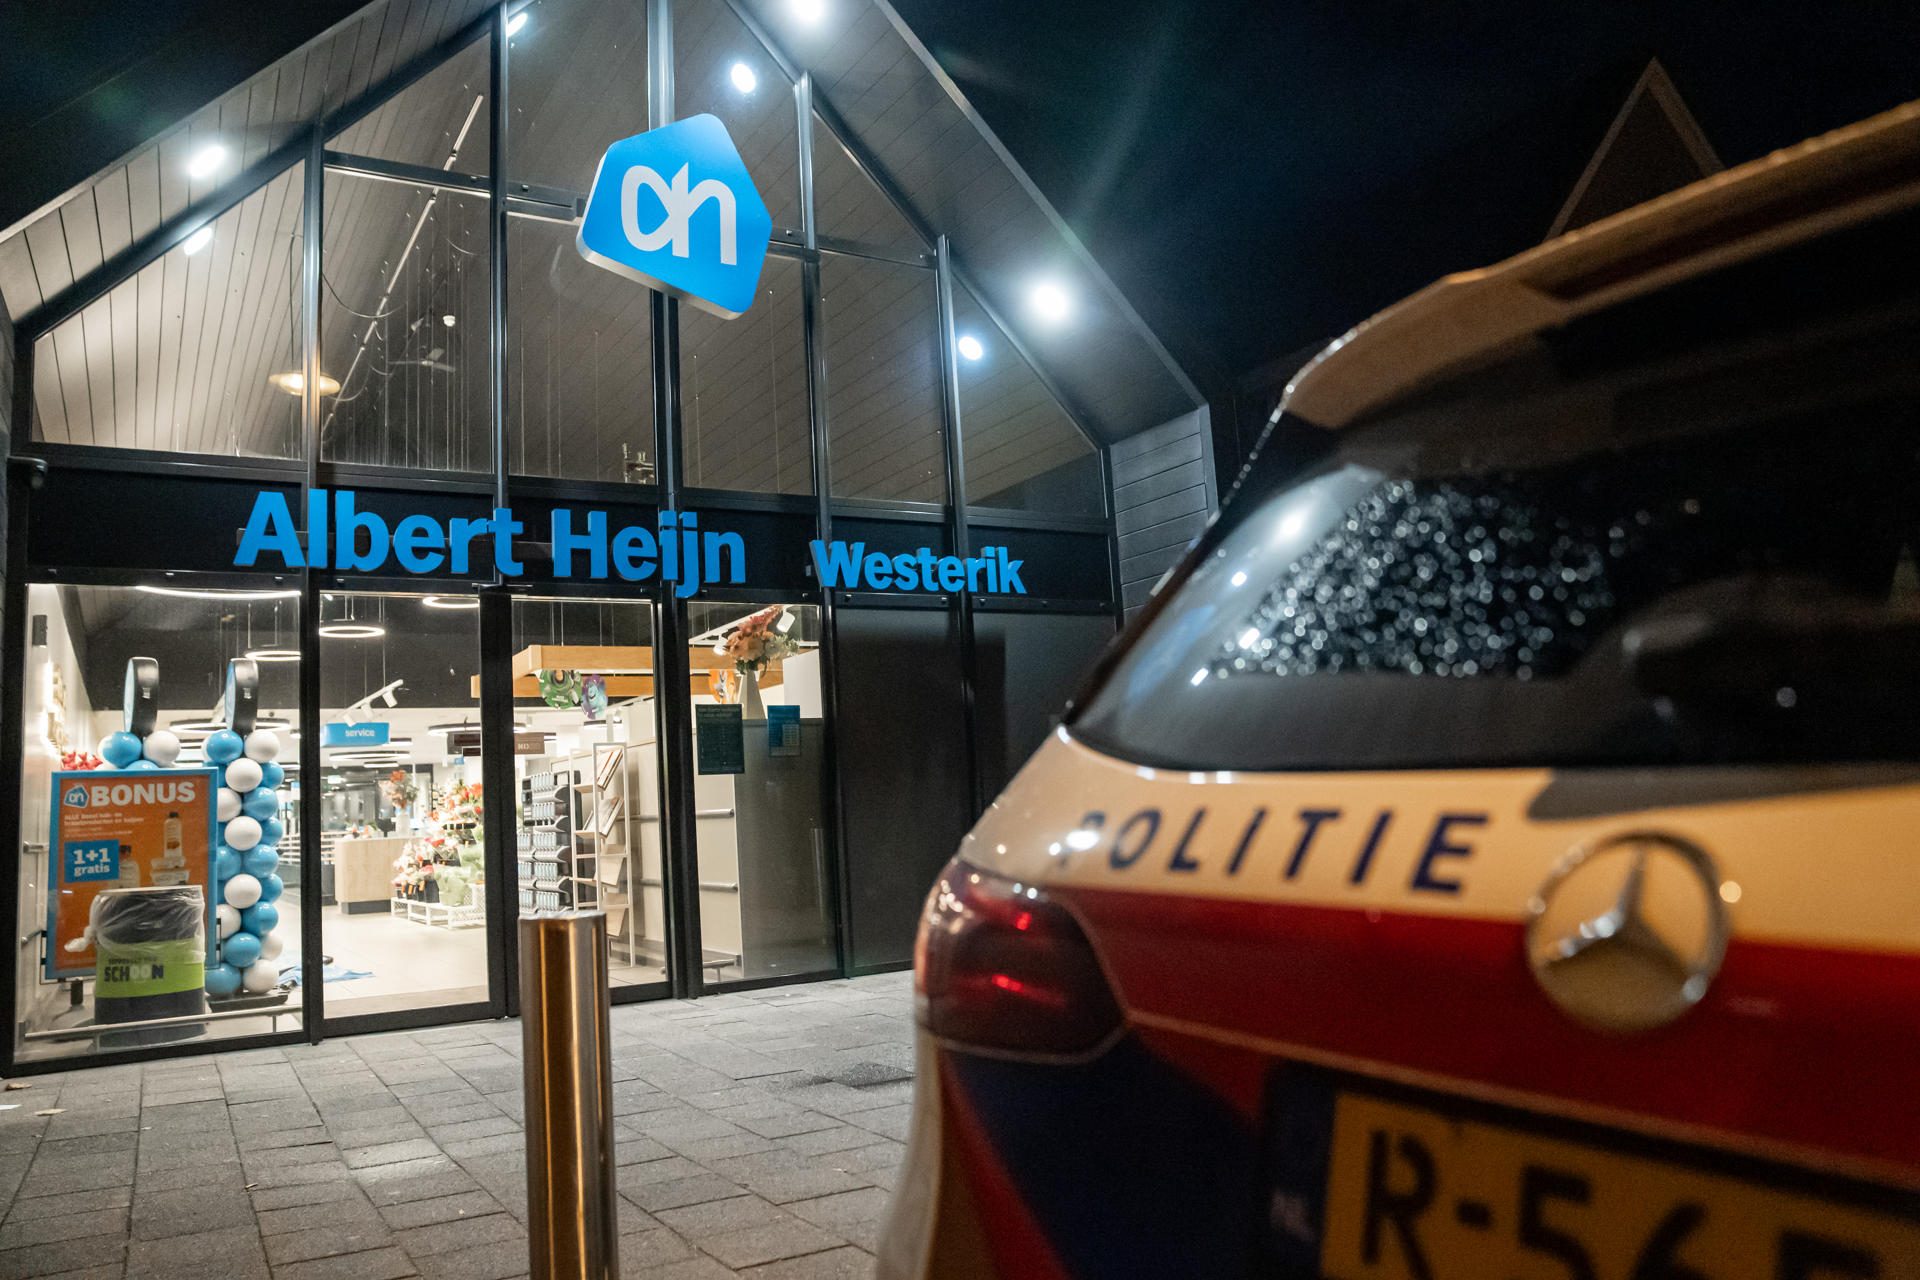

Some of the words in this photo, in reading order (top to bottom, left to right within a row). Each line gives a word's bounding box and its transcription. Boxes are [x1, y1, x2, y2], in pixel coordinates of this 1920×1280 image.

[233, 488, 524, 577] Albert
[551, 508, 747, 598] Heijn
[809, 539, 1028, 594] Westerik
[345, 729, 375, 737] service
[91, 781, 196, 807] BONUS
[73, 847, 111, 865] 1+1
[1057, 806, 1489, 894] POLITIE
[74, 863, 111, 877] gratis
[104, 964, 164, 982] SCHOON
